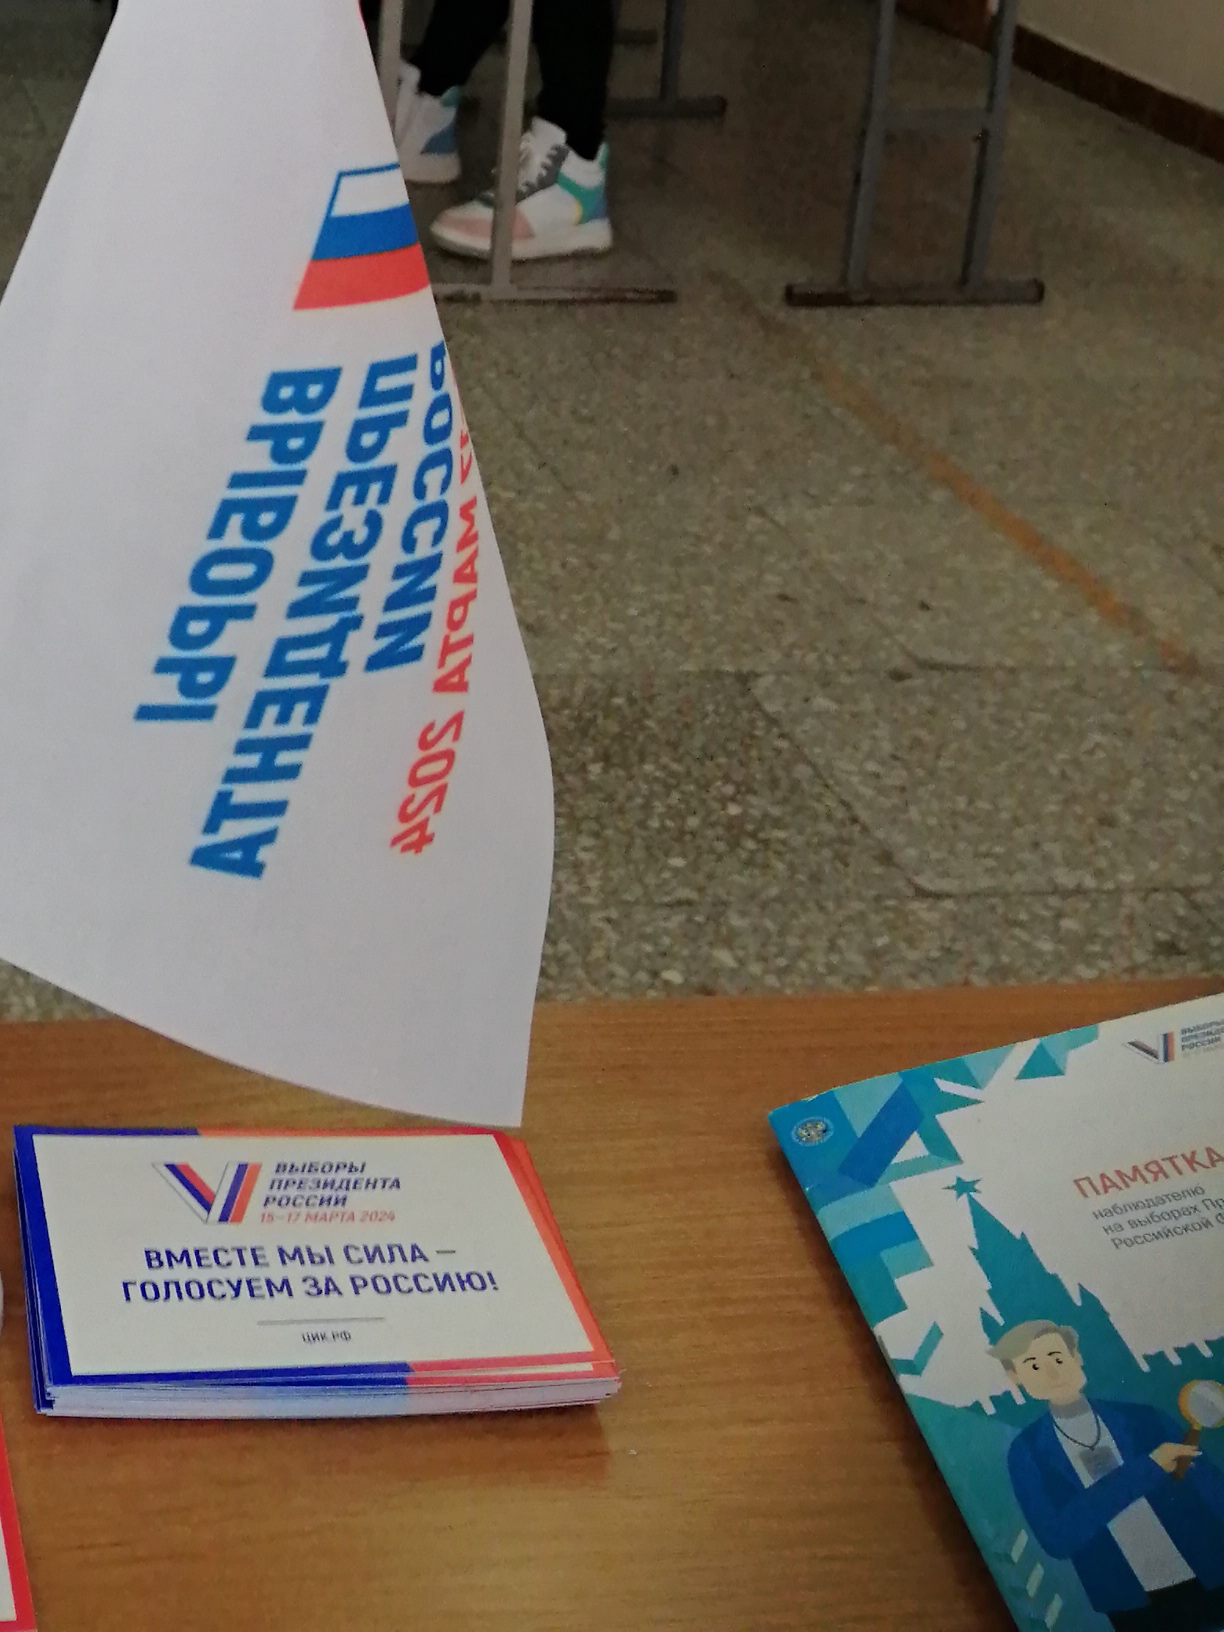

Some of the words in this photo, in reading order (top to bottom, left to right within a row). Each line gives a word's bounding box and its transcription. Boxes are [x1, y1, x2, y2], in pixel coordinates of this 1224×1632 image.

[275, 1161, 366, 1174] ВЫБОРЫ
[1073, 1146, 1224, 1198] ПАМЯТКА
[269, 1176, 401, 1192] ПРЕЗИДЕНТА
[263, 1194, 348, 1207] РОССИИ
[304, 1210, 355, 1223] МАРТА
[359, 1209, 396, 1222] 2024
[1092, 1183, 1206, 1220] наблюдателю
[1102, 1222, 1125, 1236] на
[1127, 1203, 1202, 1230] выборах
[1110, 1216, 1214, 1250] Российской
[143, 1245, 270, 1271] ВМЕСТЕ
[277, 1244, 335, 1267] МЫ
[343, 1242, 430, 1265] СИЛА
[121, 1275, 294, 1304] ГОЛОСУЕМ
[304, 1274, 344, 1298] ЗА
[349, 1270, 500, 1297] РОССИЮ!
